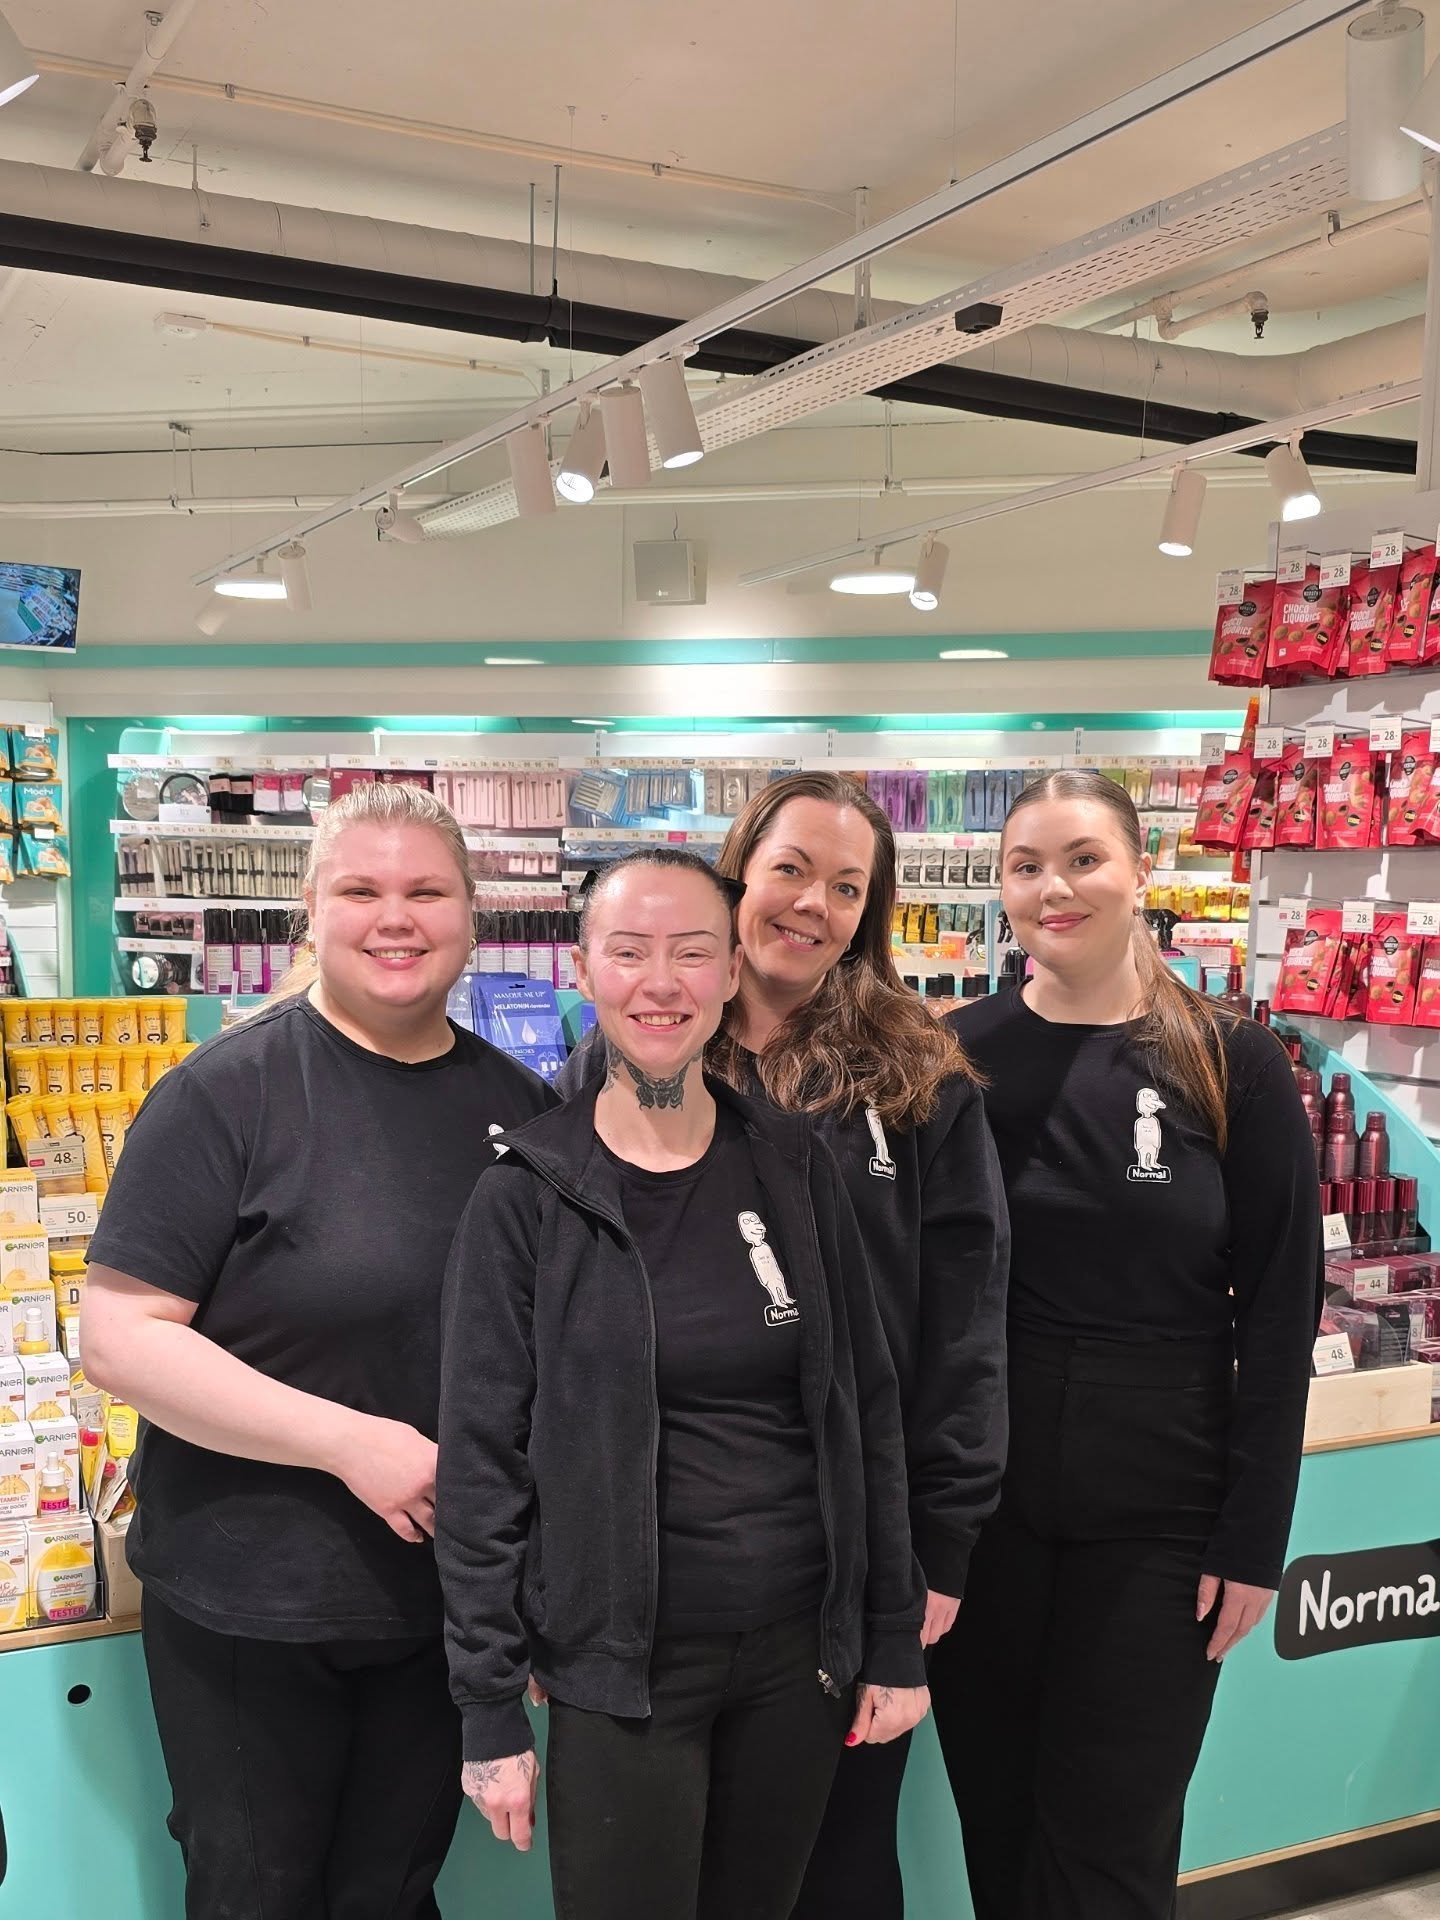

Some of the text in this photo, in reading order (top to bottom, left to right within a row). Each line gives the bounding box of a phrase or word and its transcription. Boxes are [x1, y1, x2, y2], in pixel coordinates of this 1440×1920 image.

[1283, 604, 1310, 614] CHOCO
[1283, 612, 1321, 624] LIQUORICE
[23, 787, 54, 796] Mochi
[494, 991, 523, 999] MASQUE
[102, 1133, 116, 1169] C-BOOST
[1132, 1168, 1167, 1179] Normal
[69, 1287, 80, 1305] D
[770, 1307, 800, 1321] Norma
[50, 1606, 85, 1618] TESTER
